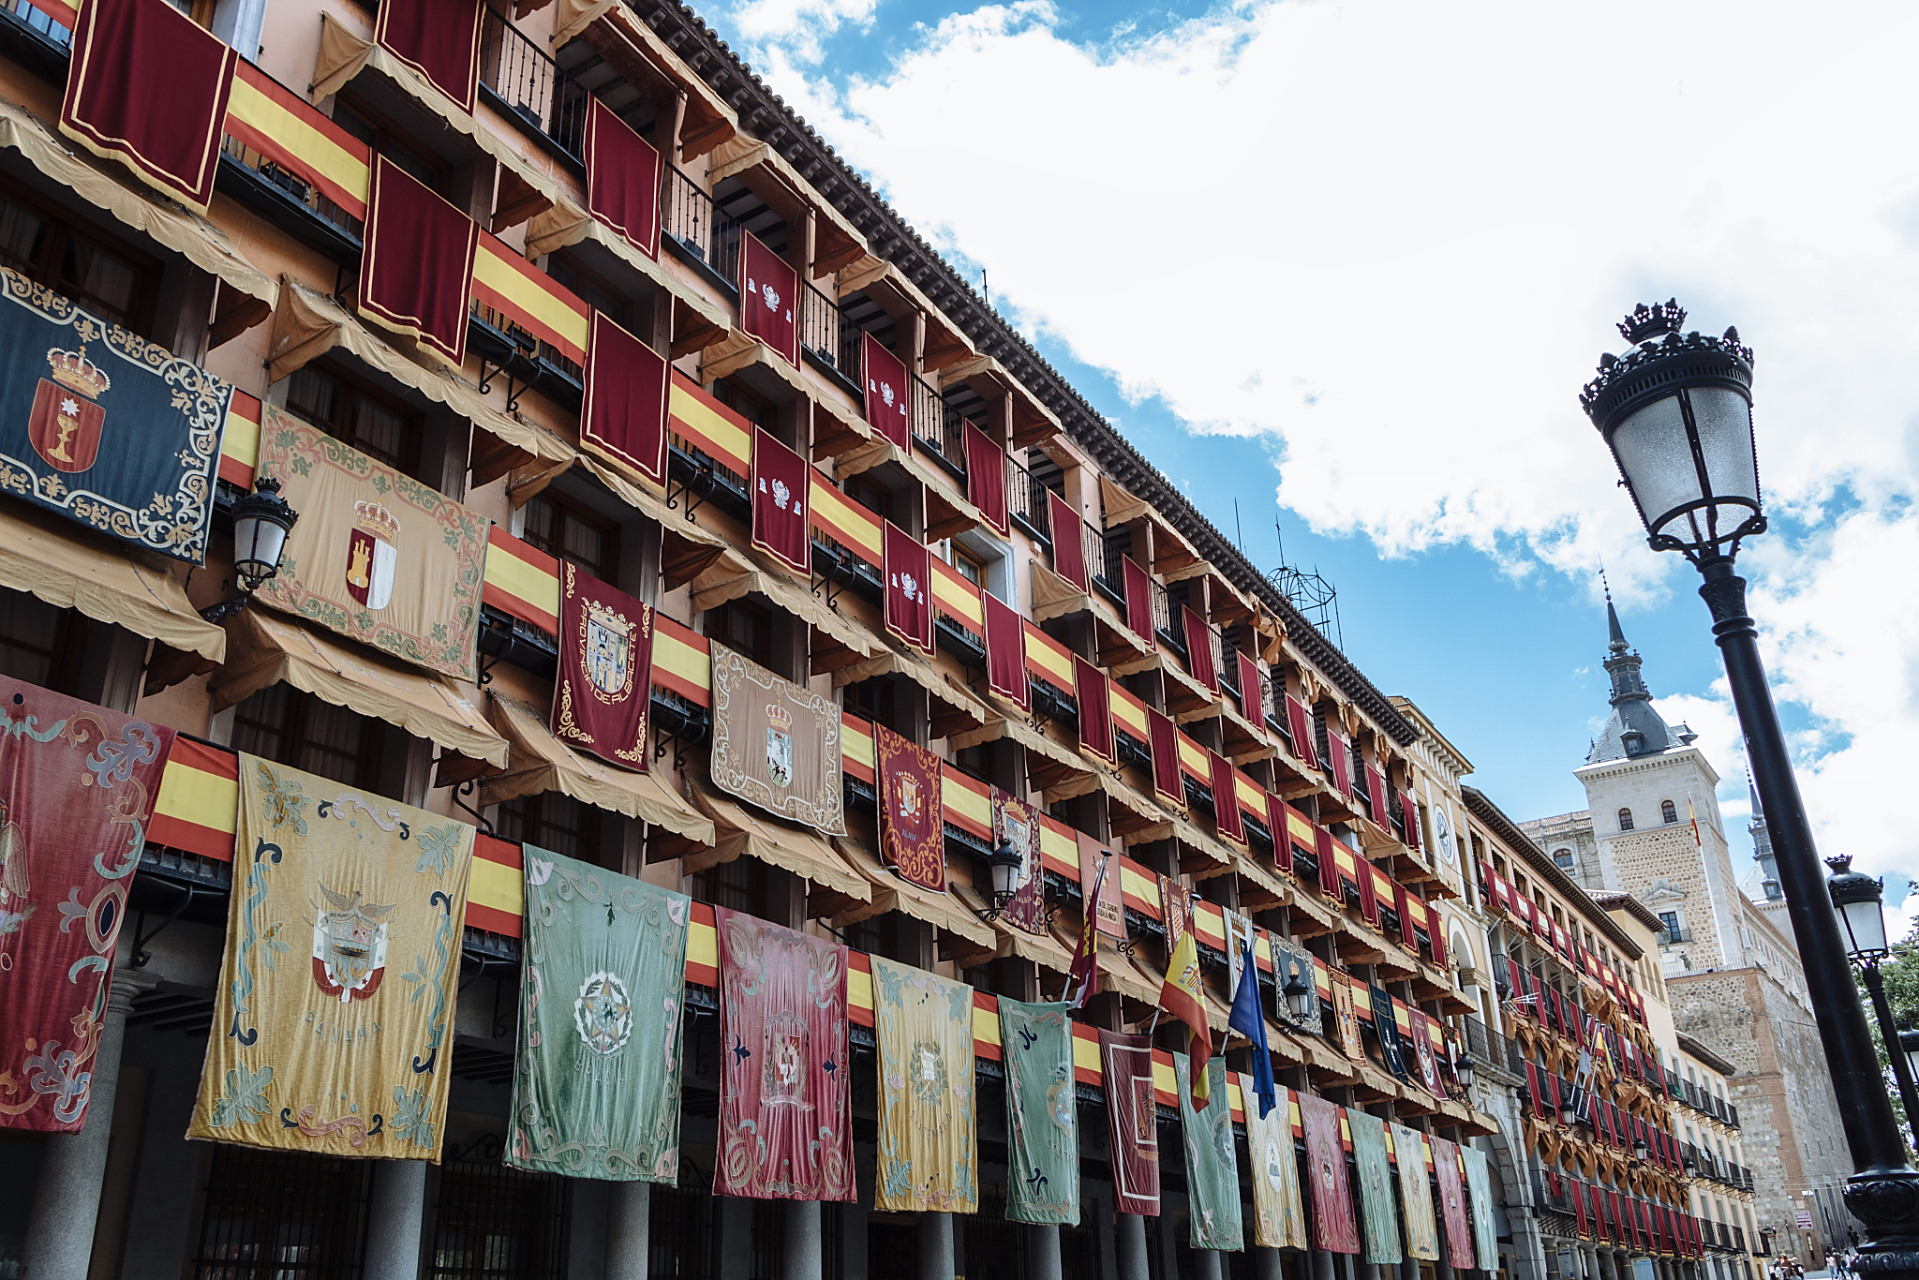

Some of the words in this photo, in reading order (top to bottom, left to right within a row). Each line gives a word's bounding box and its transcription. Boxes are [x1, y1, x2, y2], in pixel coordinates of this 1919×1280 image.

[578, 604, 595, 692] PROVINCIA
[593, 689, 612, 706] DE
[611, 631, 637, 705] ALBACETE
[303, 1010, 384, 1044] PANAMA
